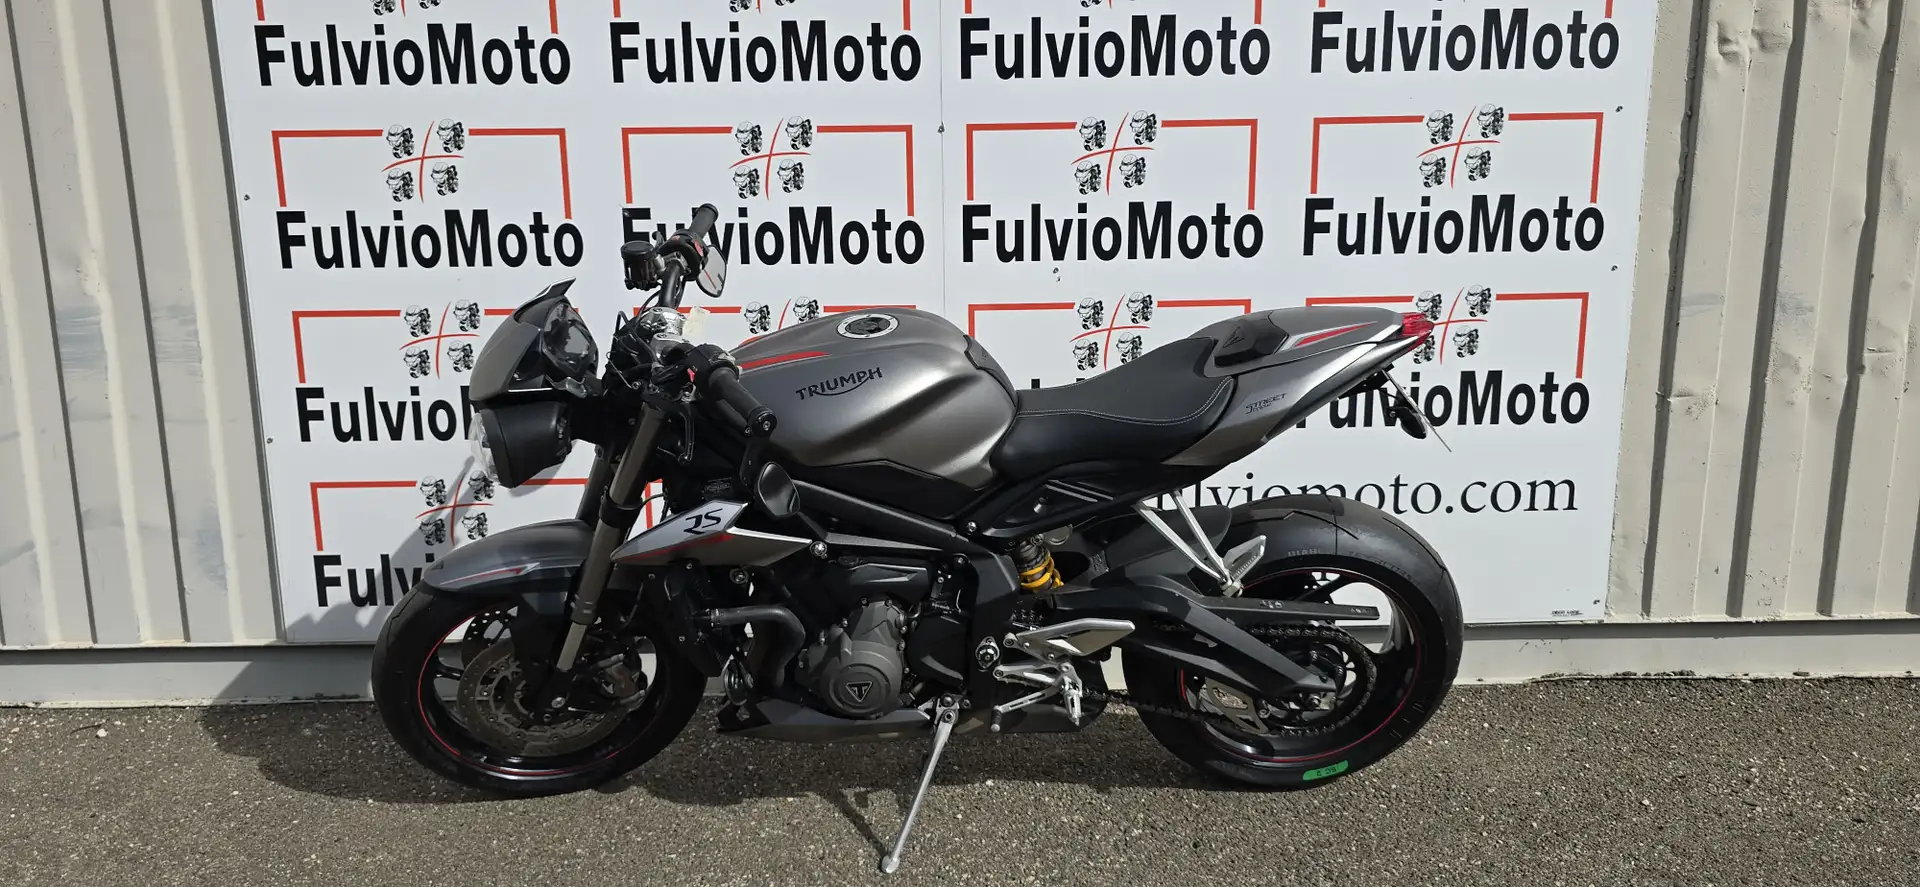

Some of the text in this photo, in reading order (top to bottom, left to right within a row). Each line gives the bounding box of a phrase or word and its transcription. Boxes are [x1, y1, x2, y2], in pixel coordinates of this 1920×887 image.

[255, 24, 571, 87] FulvioMoto
[610, 20, 921, 84] FulvioMoto
[960, 15, 1270, 80] FulvioMoto
[1311, 9, 1619, 74] FulvioMoto
[277, 209, 584, 270] FulvioMoto
[621, 206, 925, 266] FvioMoto
[962, 201, 1264, 263] FulvioMoto
[1303, 195, 1604, 257] FulvioMoto
[796, 367, 883, 400] TRIUMPH
